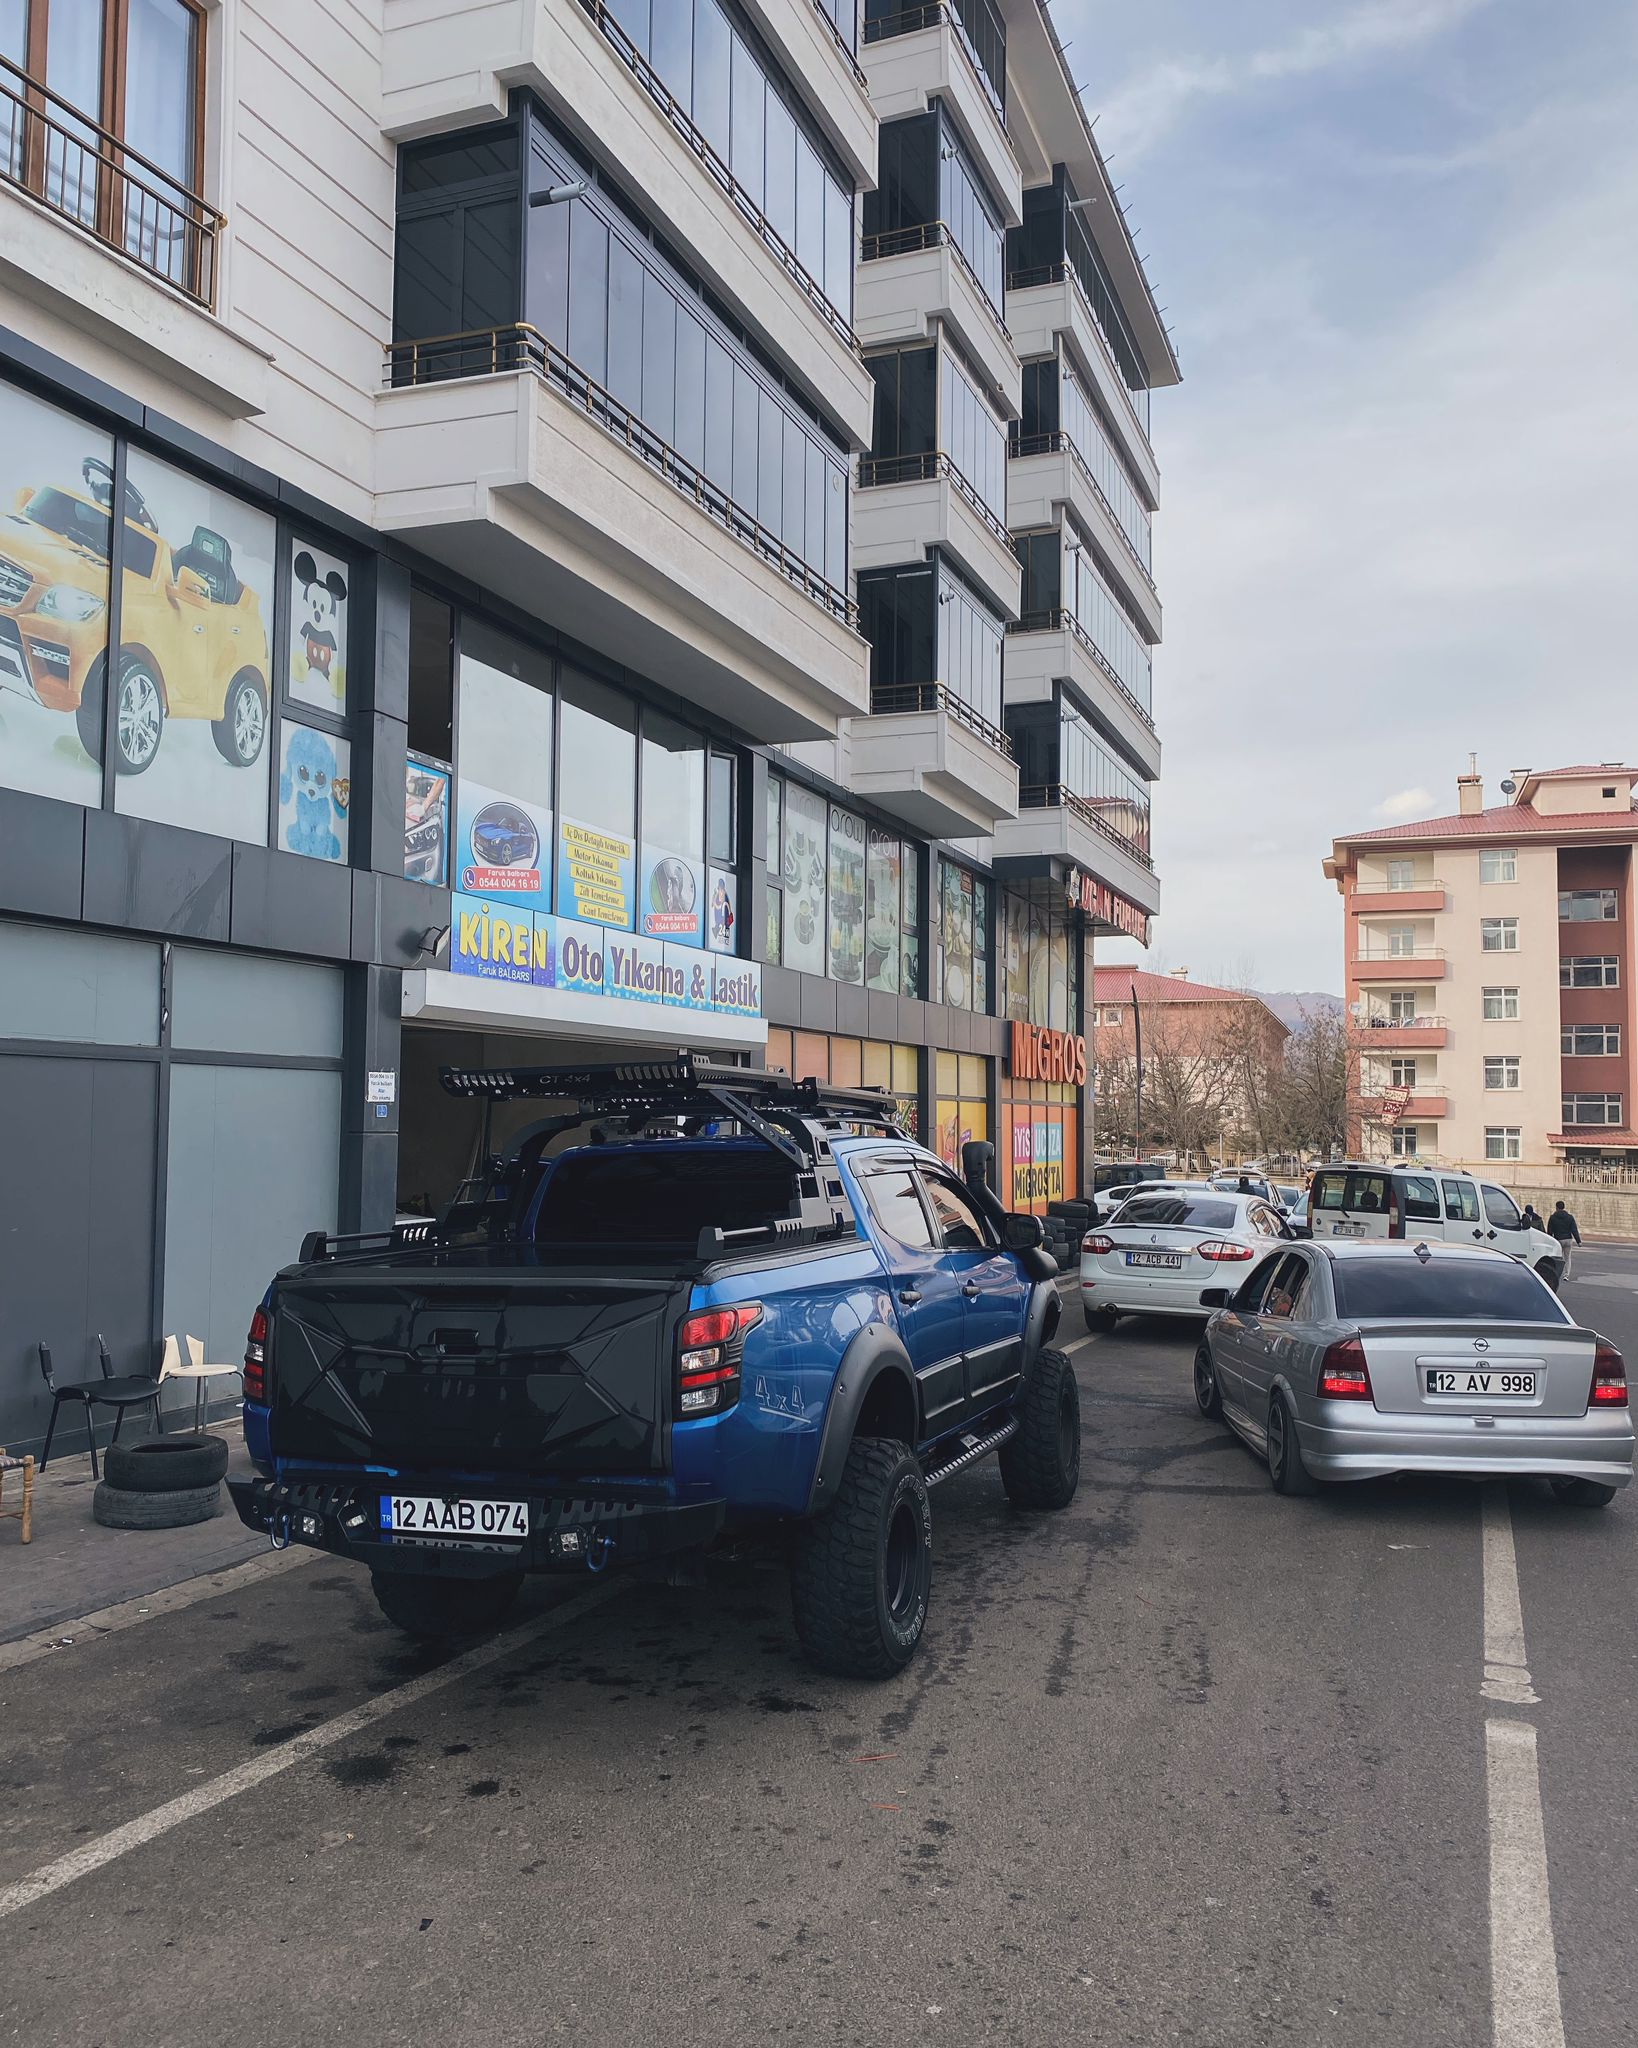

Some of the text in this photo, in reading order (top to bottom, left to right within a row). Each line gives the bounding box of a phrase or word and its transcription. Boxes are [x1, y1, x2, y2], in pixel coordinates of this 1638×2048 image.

[574, 848, 591, 860] Motor
[575, 866, 594, 880] Koltuk
[479, 877, 539, 890] 0544 004 16 19
[459, 903, 759, 1008] KİREN Oto Yıkama & Lastik
[478, 963, 530, 981] Faruk BALBARS
[1133, 1253, 1141, 1263] 12
[1146, 1254, 1162, 1264] ACB
[1165, 1255, 1179, 1265] 441
[1438, 1374, 1456, 1391] 12
[1466, 1375, 1491, 1391] AV
[1501, 1375, 1533, 1392] 998
[755, 1374, 805, 1417] 4x4
[382, 1499, 527, 1533] TR 12 AAB 074
